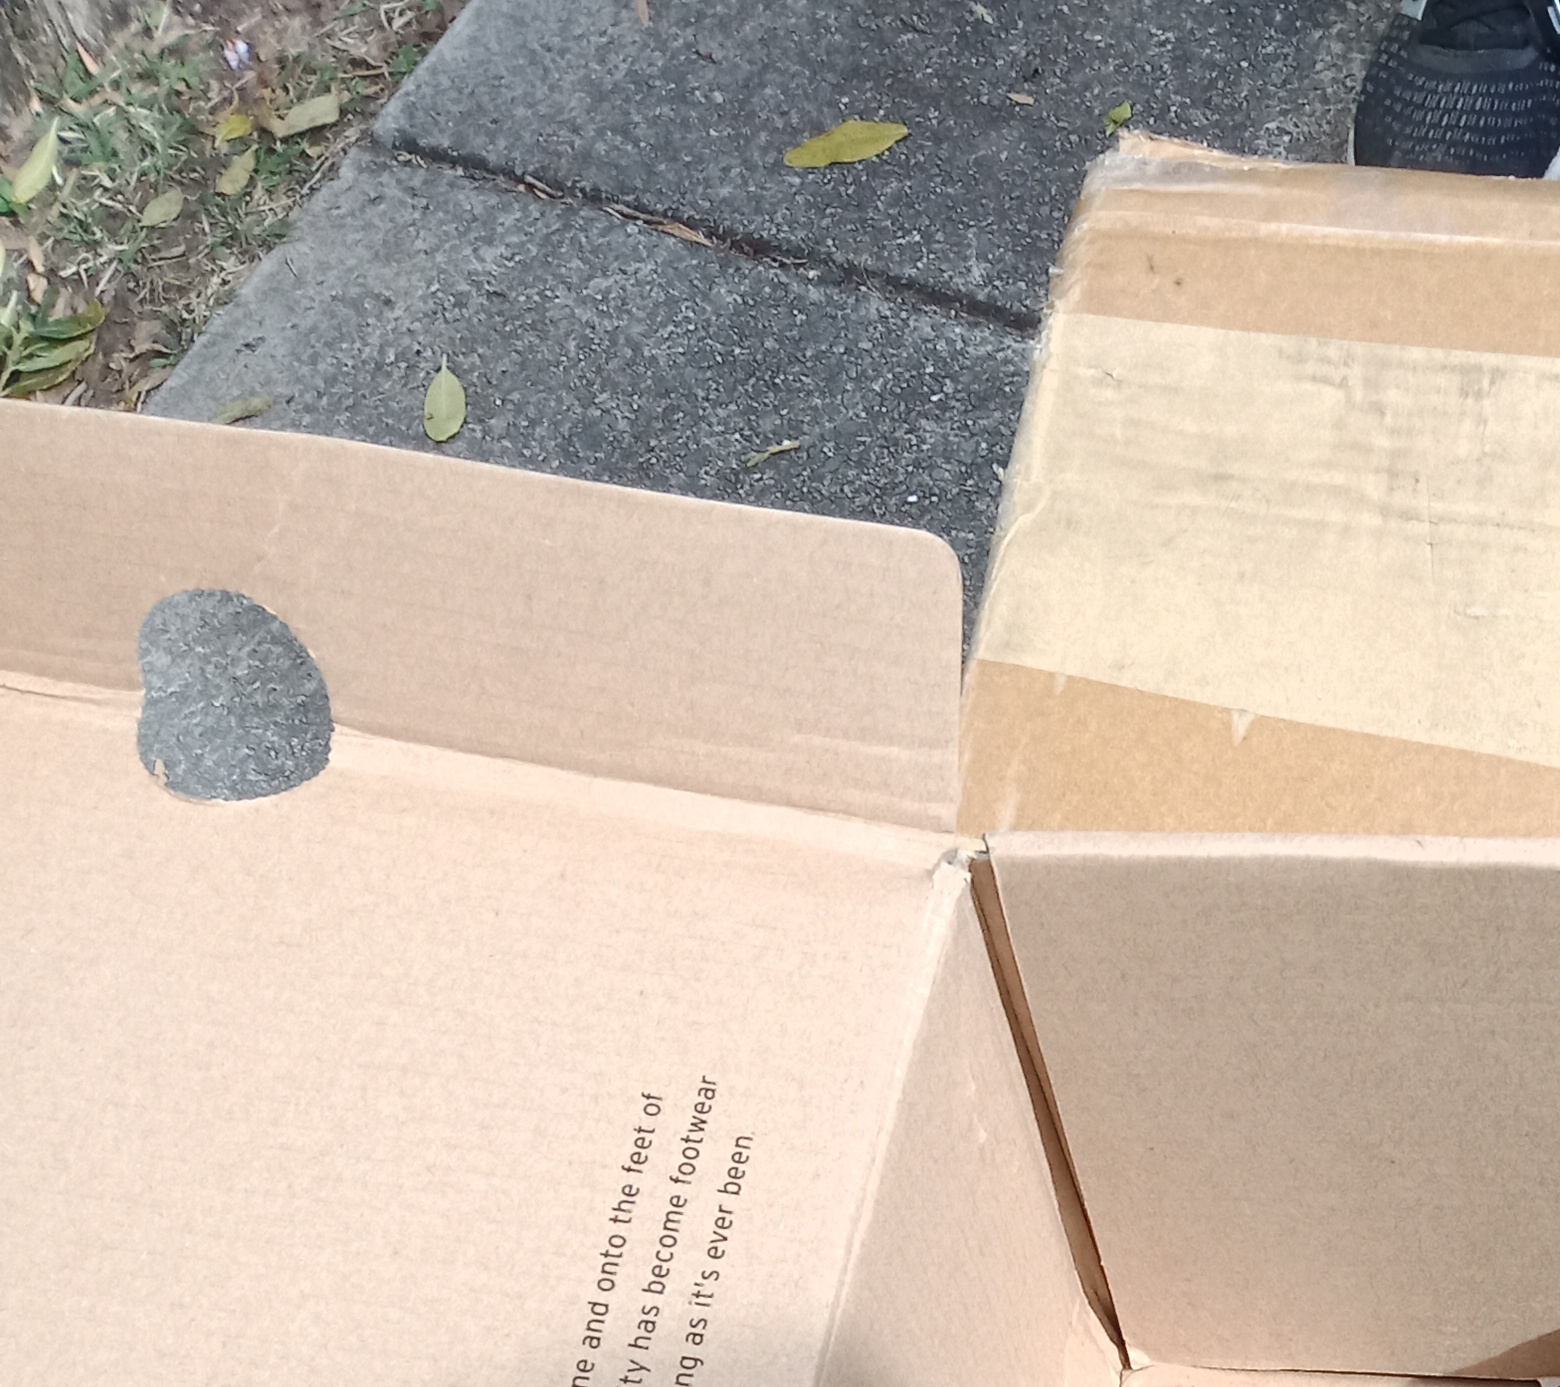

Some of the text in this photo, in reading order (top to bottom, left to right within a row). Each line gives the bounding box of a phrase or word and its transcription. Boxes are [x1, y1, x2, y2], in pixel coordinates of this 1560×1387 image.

[640, 1091, 664, 1118] of
[620, 1124, 657, 1175] feet
[668, 1074, 718, 1186] footwear
[716, 1131, 756, 1197] been.
[607, 1183, 641, 1225] the
[640, 1194, 689, 1296] become
[706, 1203, 735, 1260] ever
[596, 1233, 628, 1293] onto
[687, 1269, 721, 1308] it's
[581, 1300, 610, 1350] and
[626, 1303, 661, 1351] has
[684, 1317, 709, 1347] as
